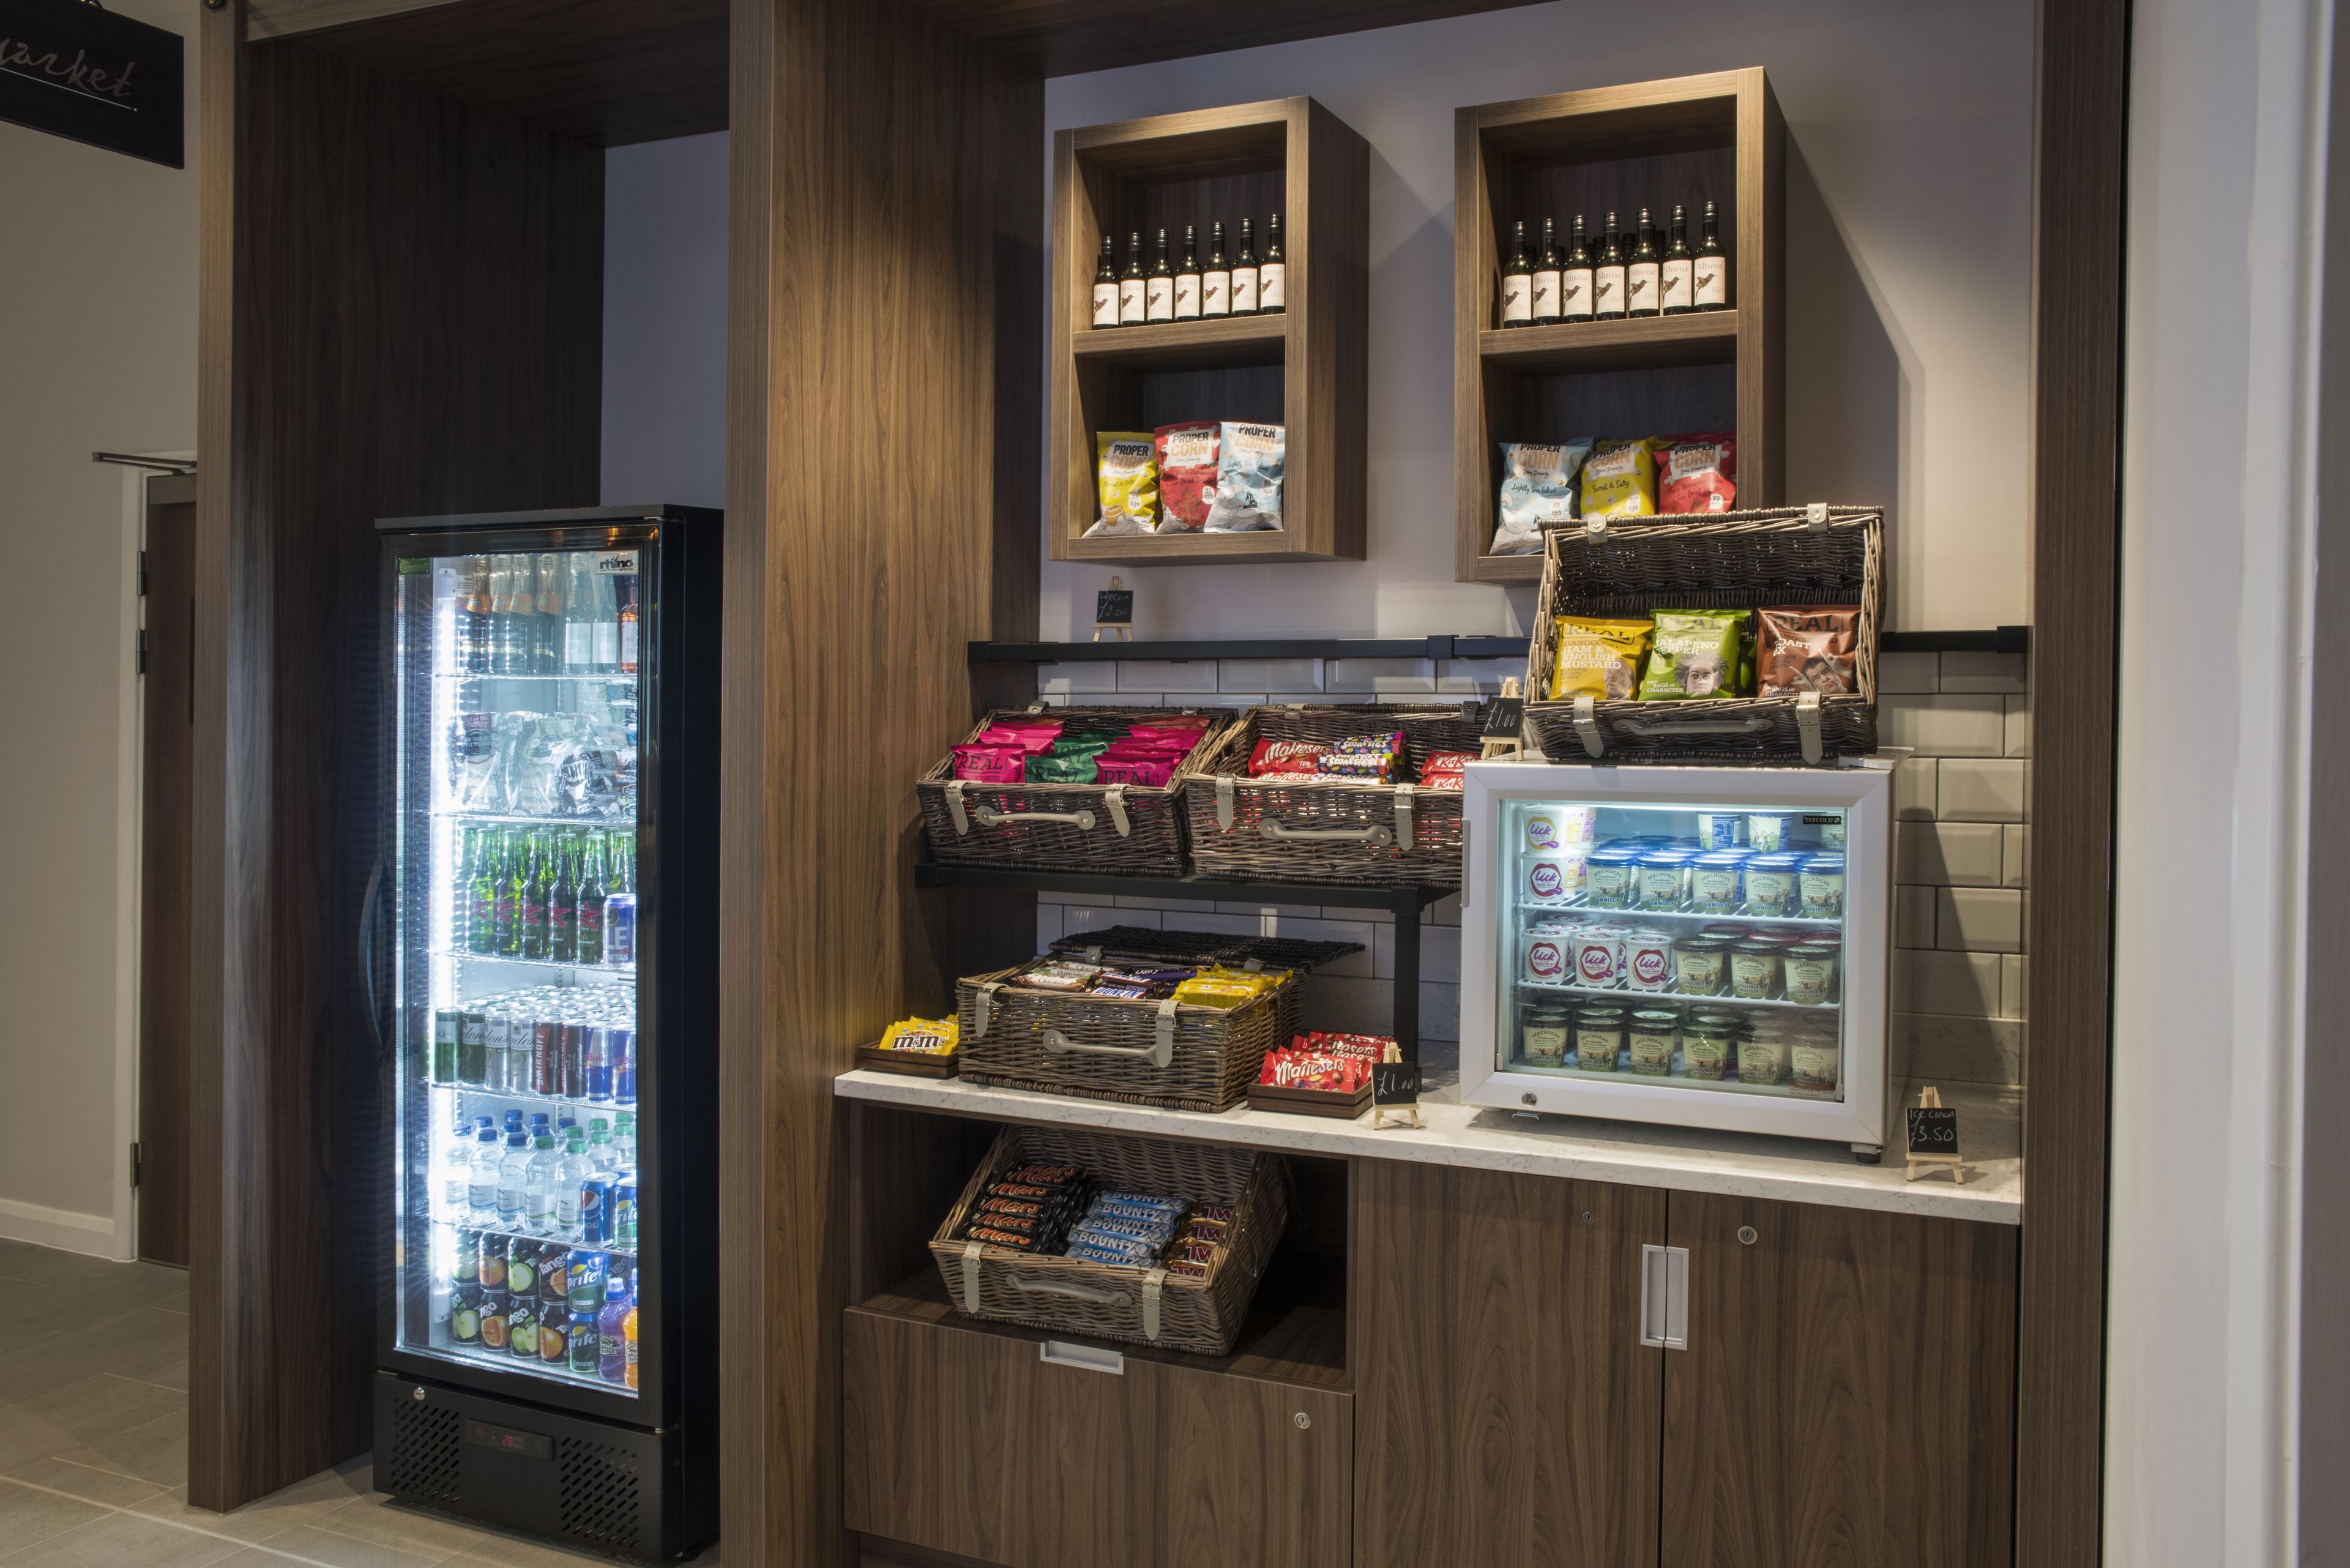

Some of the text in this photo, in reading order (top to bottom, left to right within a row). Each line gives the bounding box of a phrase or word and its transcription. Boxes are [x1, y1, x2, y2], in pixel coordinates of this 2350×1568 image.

[0, 38, 136, 97] arket
[1173, 431, 1209, 443] PROPER
[1113, 444, 1149, 457] PROPER
[1171, 442, 1209, 457] CORN
[1518, 451, 1559, 470] CORN
[1591, 449, 1630, 469] CORN
[1674, 450, 1716, 469] CORN
[1511, 483, 1529, 494] Lightly
[1592, 483, 1608, 493] Sweet
[1616, 479, 1630, 488] Salty
[600, 554, 633, 569] rhino
[1774, 614, 1838, 632] REAL
[1566, 624, 1630, 641] REAL
[1655, 639, 1719, 649] JALAPENO
[1484, 701, 1516, 733] £1.00
[1265, 741, 1330, 764] Maltesers
[957, 755, 1003, 771] REAL
[1103, 770, 1155, 786] REAL
[1530, 823, 1551, 835] lick
[1535, 870, 1557, 882] lick
[1593, 869, 1622, 878] BEECHDEAN
[1647, 872, 1677, 881] BEECHDEAN
[1701, 873, 1731, 882] BEECHDEAN
[1751, 876, 1781, 886] BEECHDEAN
[606, 927, 628, 950] LE
[1534, 949, 1555, 961] lick
[1584, 952, 1606, 965] lick
[1639, 957, 1661, 968] lick
[1681, 955, 1711, 965] BEECHDEAN
[1736, 958, 1766, 968] BEECHDEAN
[1794, 963, 1824, 972] BEECHDEAN
[1531, 1031, 1560, 1039] BEECHDEAN
[535, 1032, 545, 1085] SMIRNOFF
[1275, 1058, 1346, 1086] Maltesers
[1377, 1071, 1414, 1096] £1.00
[990, 1182, 1048, 1195] Mars
[982, 1197, 1039, 1214] Mars
[1112, 1193, 1171, 1205] BOUNTY
[1102, 1203, 1162, 1220] BOUNTY
[976, 1212, 1037, 1228] Mars
[971, 1228, 1031, 1245] Mars
[1092, 1220, 1151, 1238] BOUNTY
[1078, 1231, 1137, 1252] BOUNTY
[1081, 1248, 1141, 1265] BOUNTY
[567, 1269, 598, 1290] prite
[480, 1302, 498, 1318] ngo
[509, 1307, 529, 1326] ngo
[569, 1330, 597, 1348] prite
